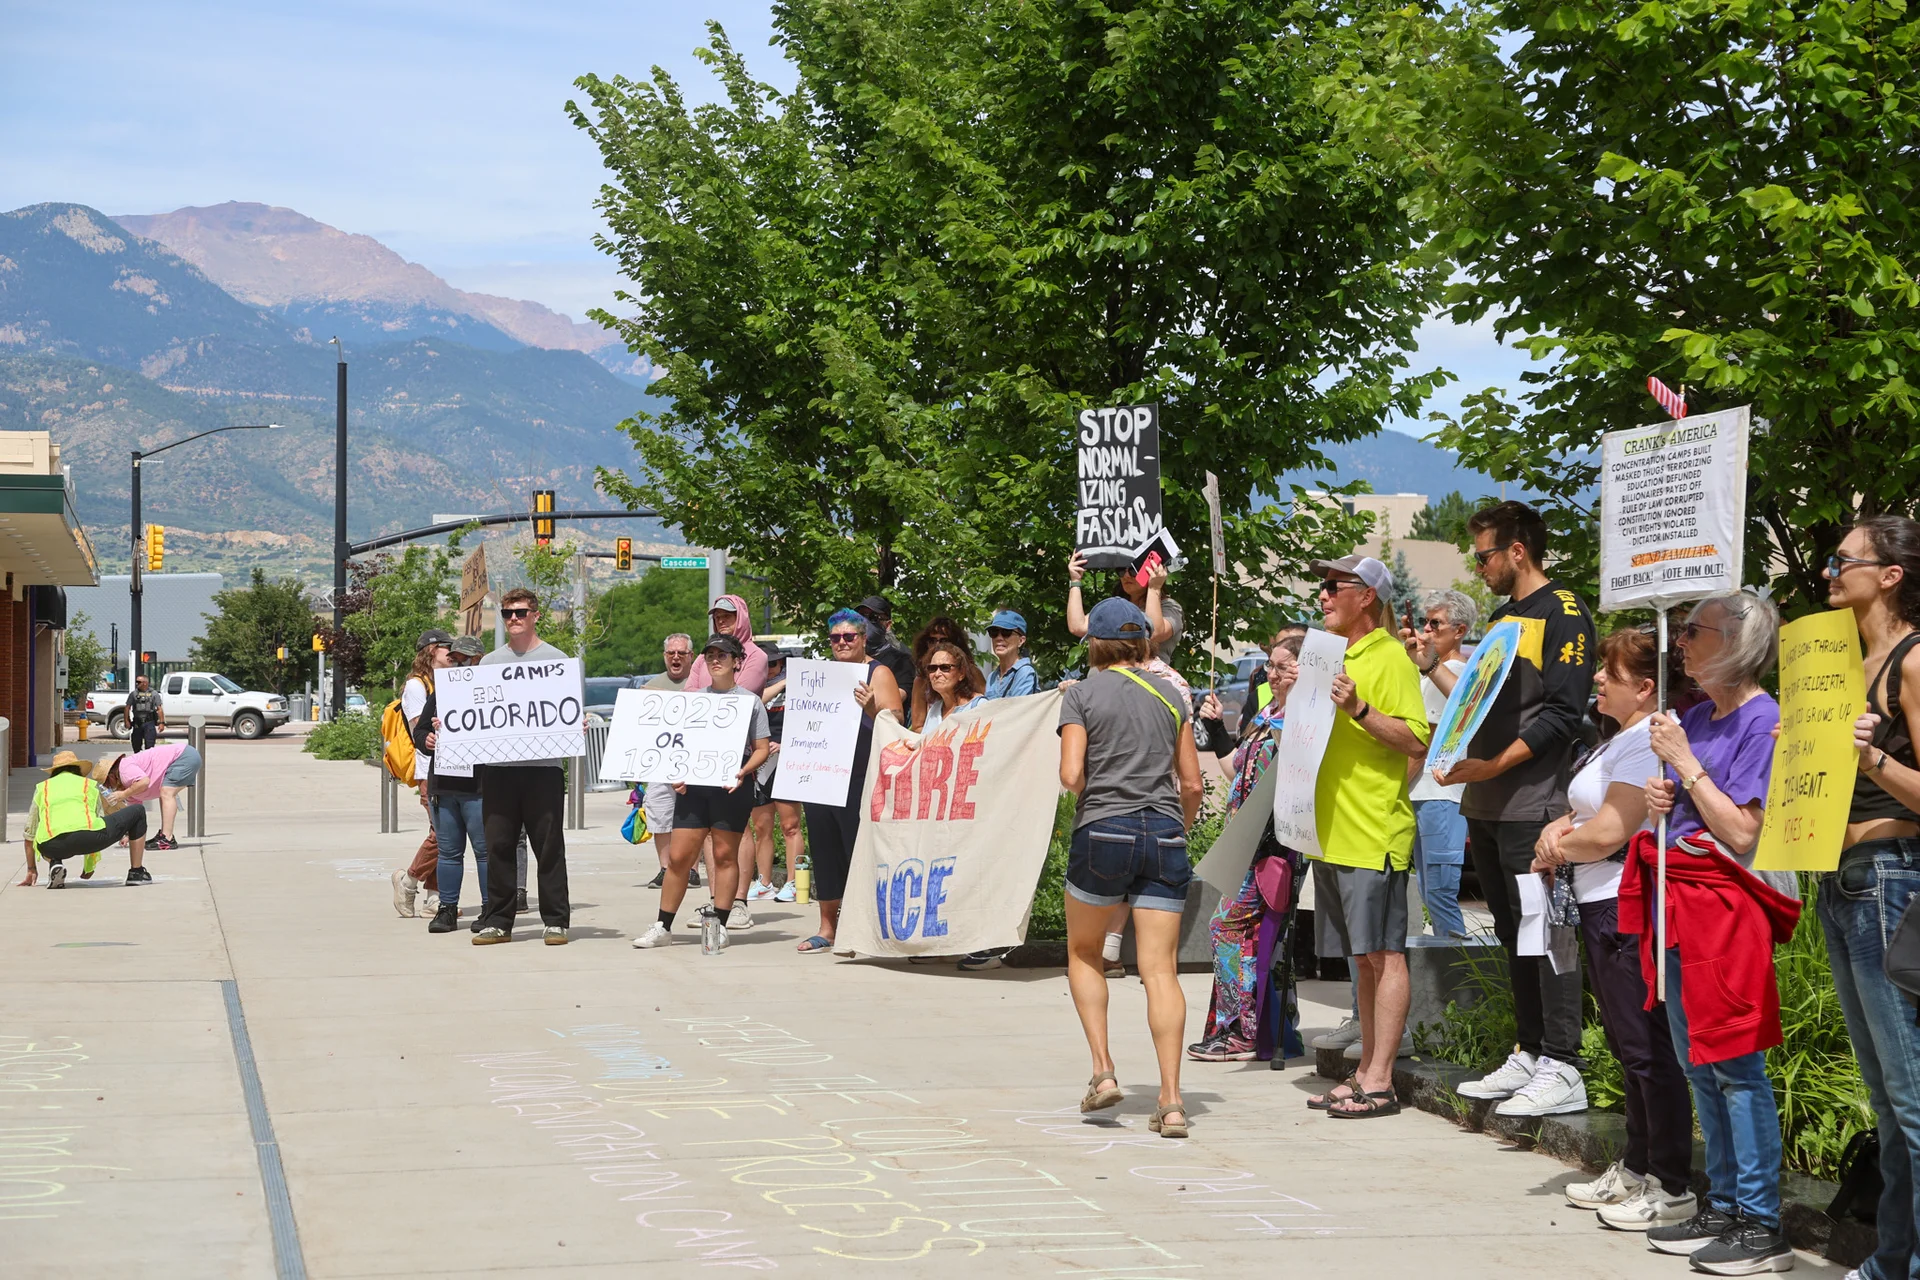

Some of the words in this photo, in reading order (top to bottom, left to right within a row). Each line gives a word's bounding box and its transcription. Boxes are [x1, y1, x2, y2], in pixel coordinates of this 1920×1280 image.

[1079, 407, 1152, 446] STOP
[1624, 435, 1666, 454] CRANK's
[1670, 423, 1718, 445] AMERICA
[1611, 455, 1666, 472] CONCENTRATION
[1667, 450, 1692, 461] CAMPS
[1693, 445, 1712, 456] BUILT
[1615, 470, 1642, 483] MASKED
[1643, 465, 1665, 477] THUGS
[1666, 456, 1712, 472] TERRORIZING
[1080, 478, 1127, 508] IZING
[1621, 488, 1664, 503] BILLIONAIRES
[1665, 484, 1688, 495] PAYED
[1689, 480, 1702, 491] OFF
[1627, 477, 1666, 492] EDUCATION
[1666, 470, 1702, 484] DEFUNDED
[1622, 504, 1638, 515] RULE
[1639, 503, 1647, 512] OF
[1648, 498, 1664, 509] LAW
[1664, 492, 1705, 506] CORRUPTED
[1077, 496, 1163, 547] FASCISM
[1618, 512, 1662, 526] CONSTITUTION
[1663, 506, 1697, 519] IGNORED
[1622, 526, 1638, 537] CIVIL
[1638, 522, 1661, 534] RIGHTS
[1663, 517, 1697, 530] VIOLATED
[1632, 533, 1661, 546] DICTATOR
[1662, 528, 1699, 541] INSTALLED
[663, 558, 697, 567] Cascade
[1611, 574, 1631, 588] FIGHT
[1633, 570, 1654, 585] BACK!
[1662, 567, 1682, 580] VOTE
[1684, 566, 1701, 577] HIM
[1704, 563, 1724, 575] OUT!
[1576, 633, 1586, 667] vivo
[1814, 638, 1848, 654] THROUGH
[448, 667, 474, 683] NO
[501, 662, 565, 682] CAMPS
[801, 671, 827, 698] Fight
[473, 685, 505, 705] IN
[789, 698, 841, 714] IGNORANCE
[1309, 687, 1317, 708] A
[444, 696, 581, 733] COLORADO
[638, 693, 739, 729] 2025
[1806, 706, 1834, 723] GROWS
[1839, 703, 1852, 722] UP
[806, 720, 824, 732] NOT
[656, 731, 685, 749] OR
[790, 737, 828, 754] Immigrants
[1802, 738, 1816, 756] AN
[620, 748, 739, 782] 1935?
[870, 722, 991, 822] FIRE
[876, 856, 957, 942] ICE
[462, 1050, 579, 1070] NO
[662, 1014, 835, 1067] DEFEND
[768, 1073, 923, 1107] THE
[591, 1077, 788, 1120] DUE
[486, 1073, 697, 1202] CONCENTRATION
[681, 1133, 986, 1262] PROCESS
